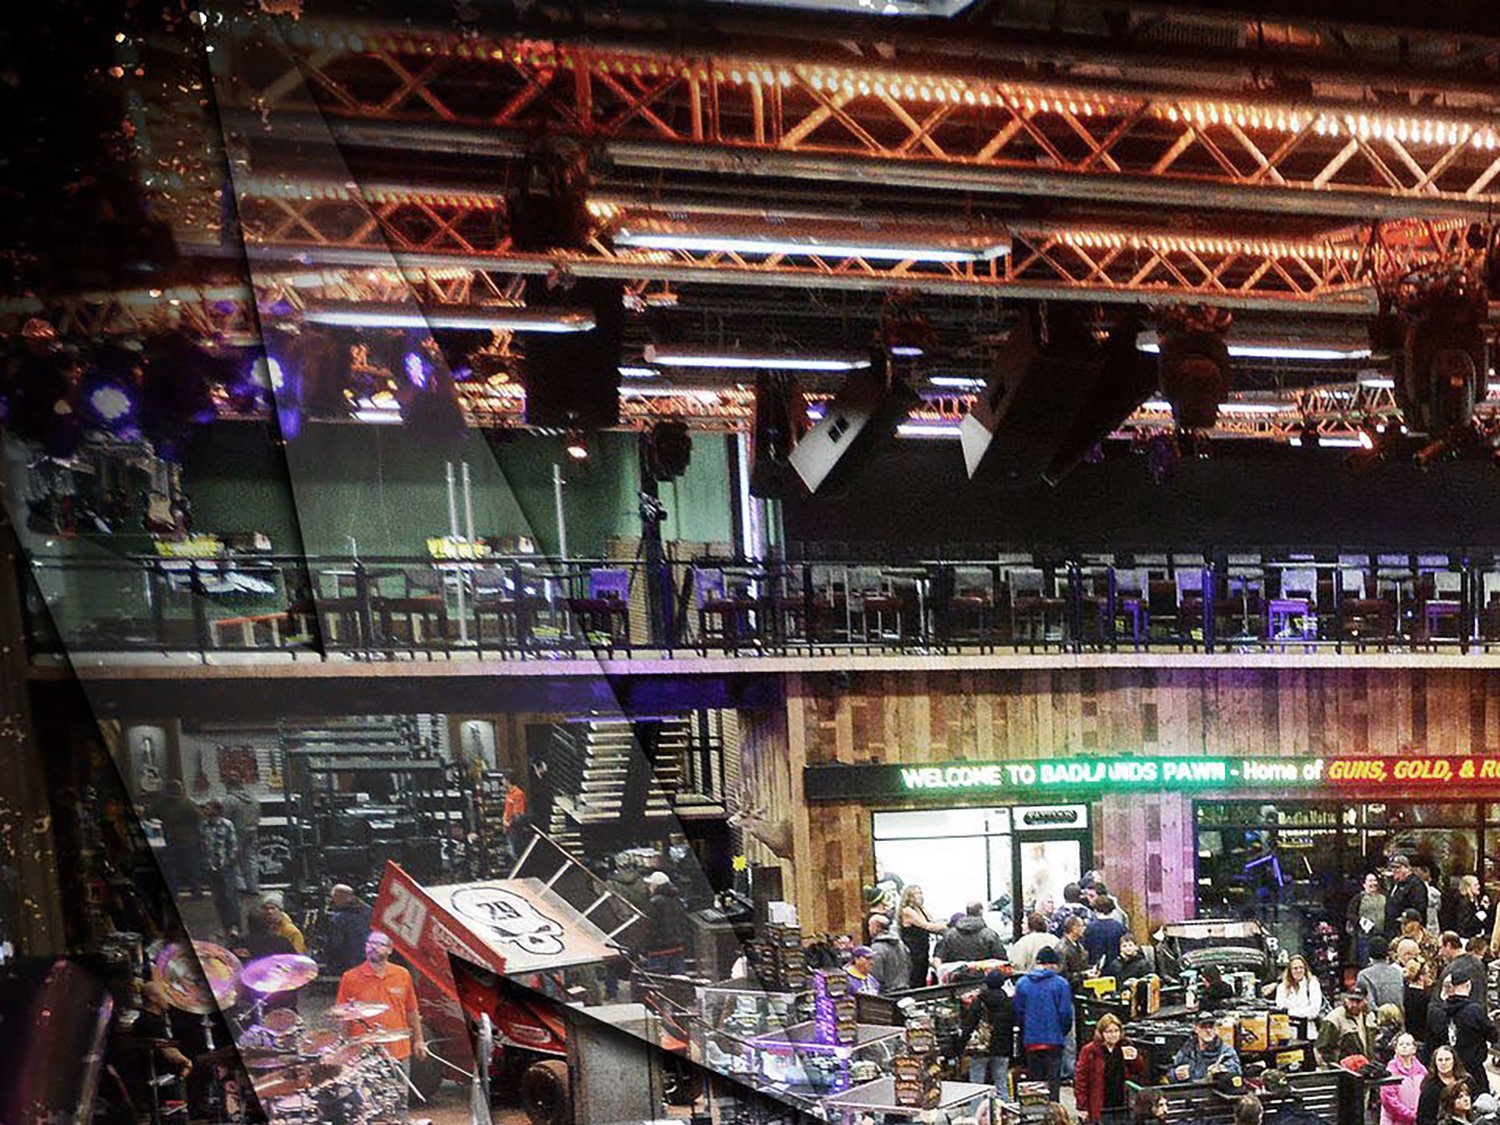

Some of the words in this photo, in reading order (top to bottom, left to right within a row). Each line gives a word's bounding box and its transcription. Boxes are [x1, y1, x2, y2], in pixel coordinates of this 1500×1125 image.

[900, 764, 1001, 789] WELCOME
[1006, 764, 1036, 786] TO
[1163, 761, 1226, 783] PAWN
[1243, 759, 1298, 781] Home
[1302, 758, 1325, 780] of
[1328, 759, 1387, 783] GUNS,
[1393, 759, 1453, 782] GOLD,
[1458, 760, 1476, 777] &
[381, 881, 428, 947] 29
